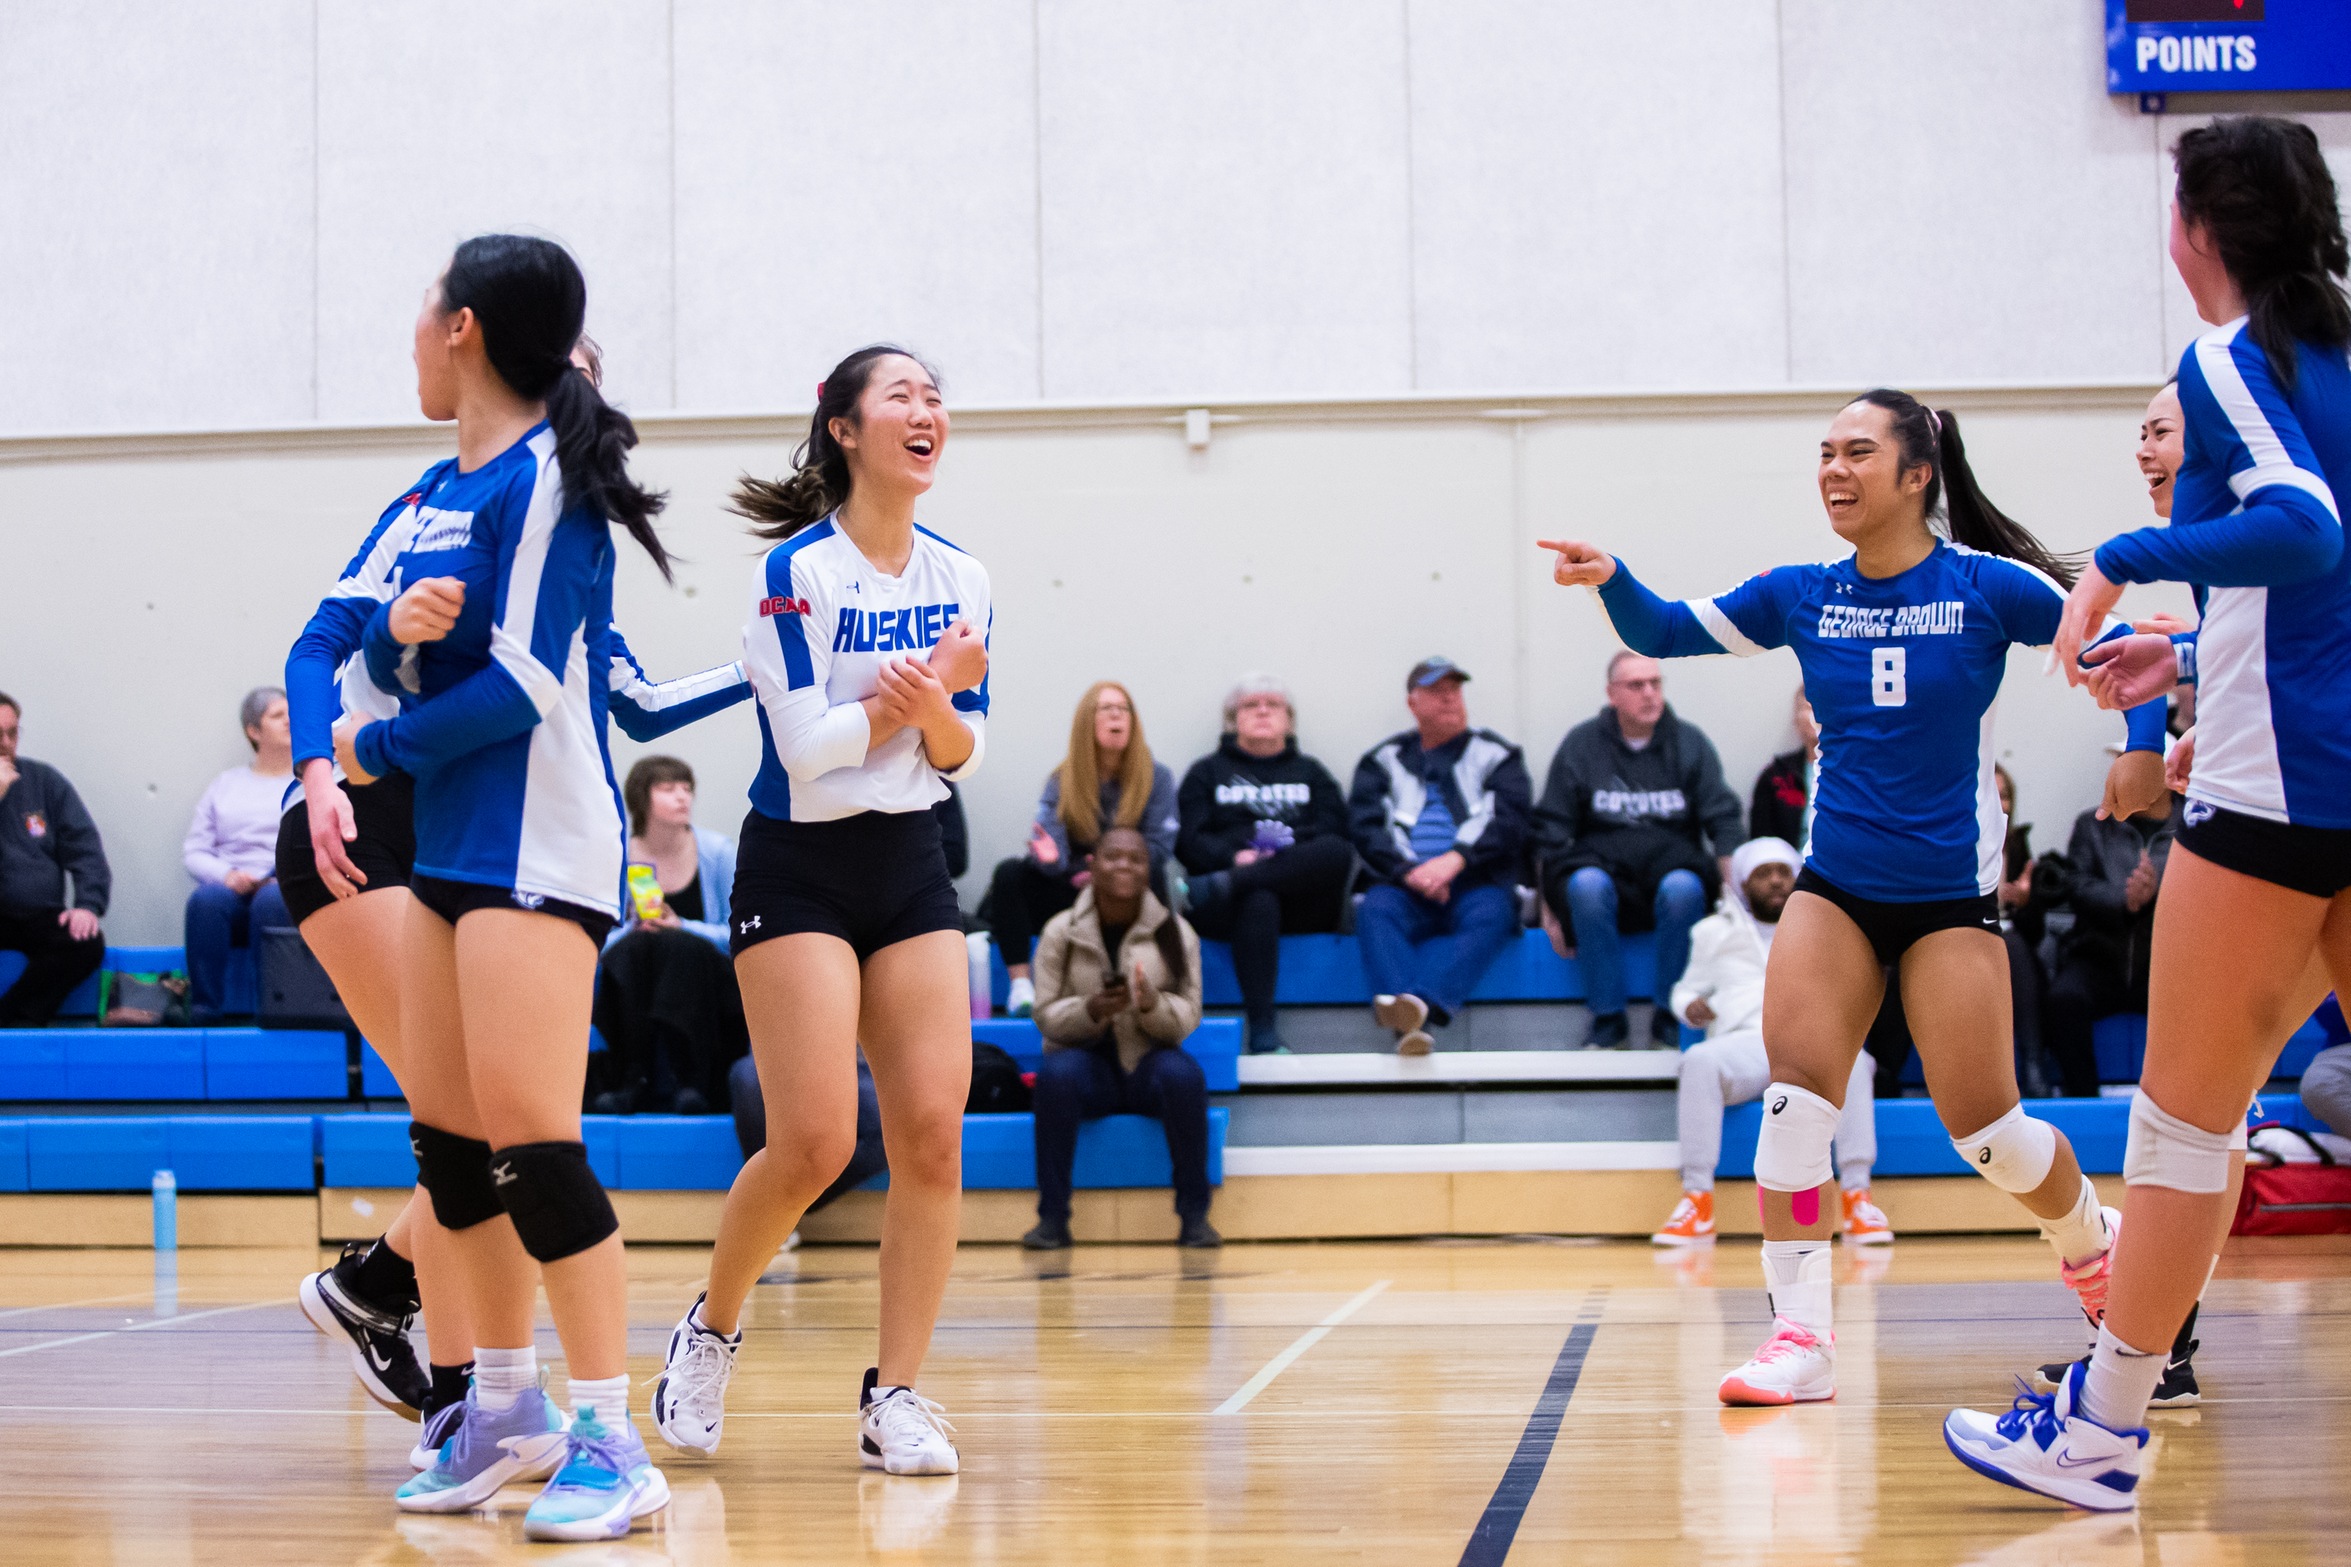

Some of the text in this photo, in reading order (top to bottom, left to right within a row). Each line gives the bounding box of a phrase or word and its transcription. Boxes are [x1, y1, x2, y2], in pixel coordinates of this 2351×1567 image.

[2136, 35, 2257, 73] POINTS
[759, 596, 812, 618] OCAA
[1818, 601, 1964, 638] GEORGE BROWN
[832, 603, 960, 653] HUSKIES
[1872, 646, 1907, 707] 8
